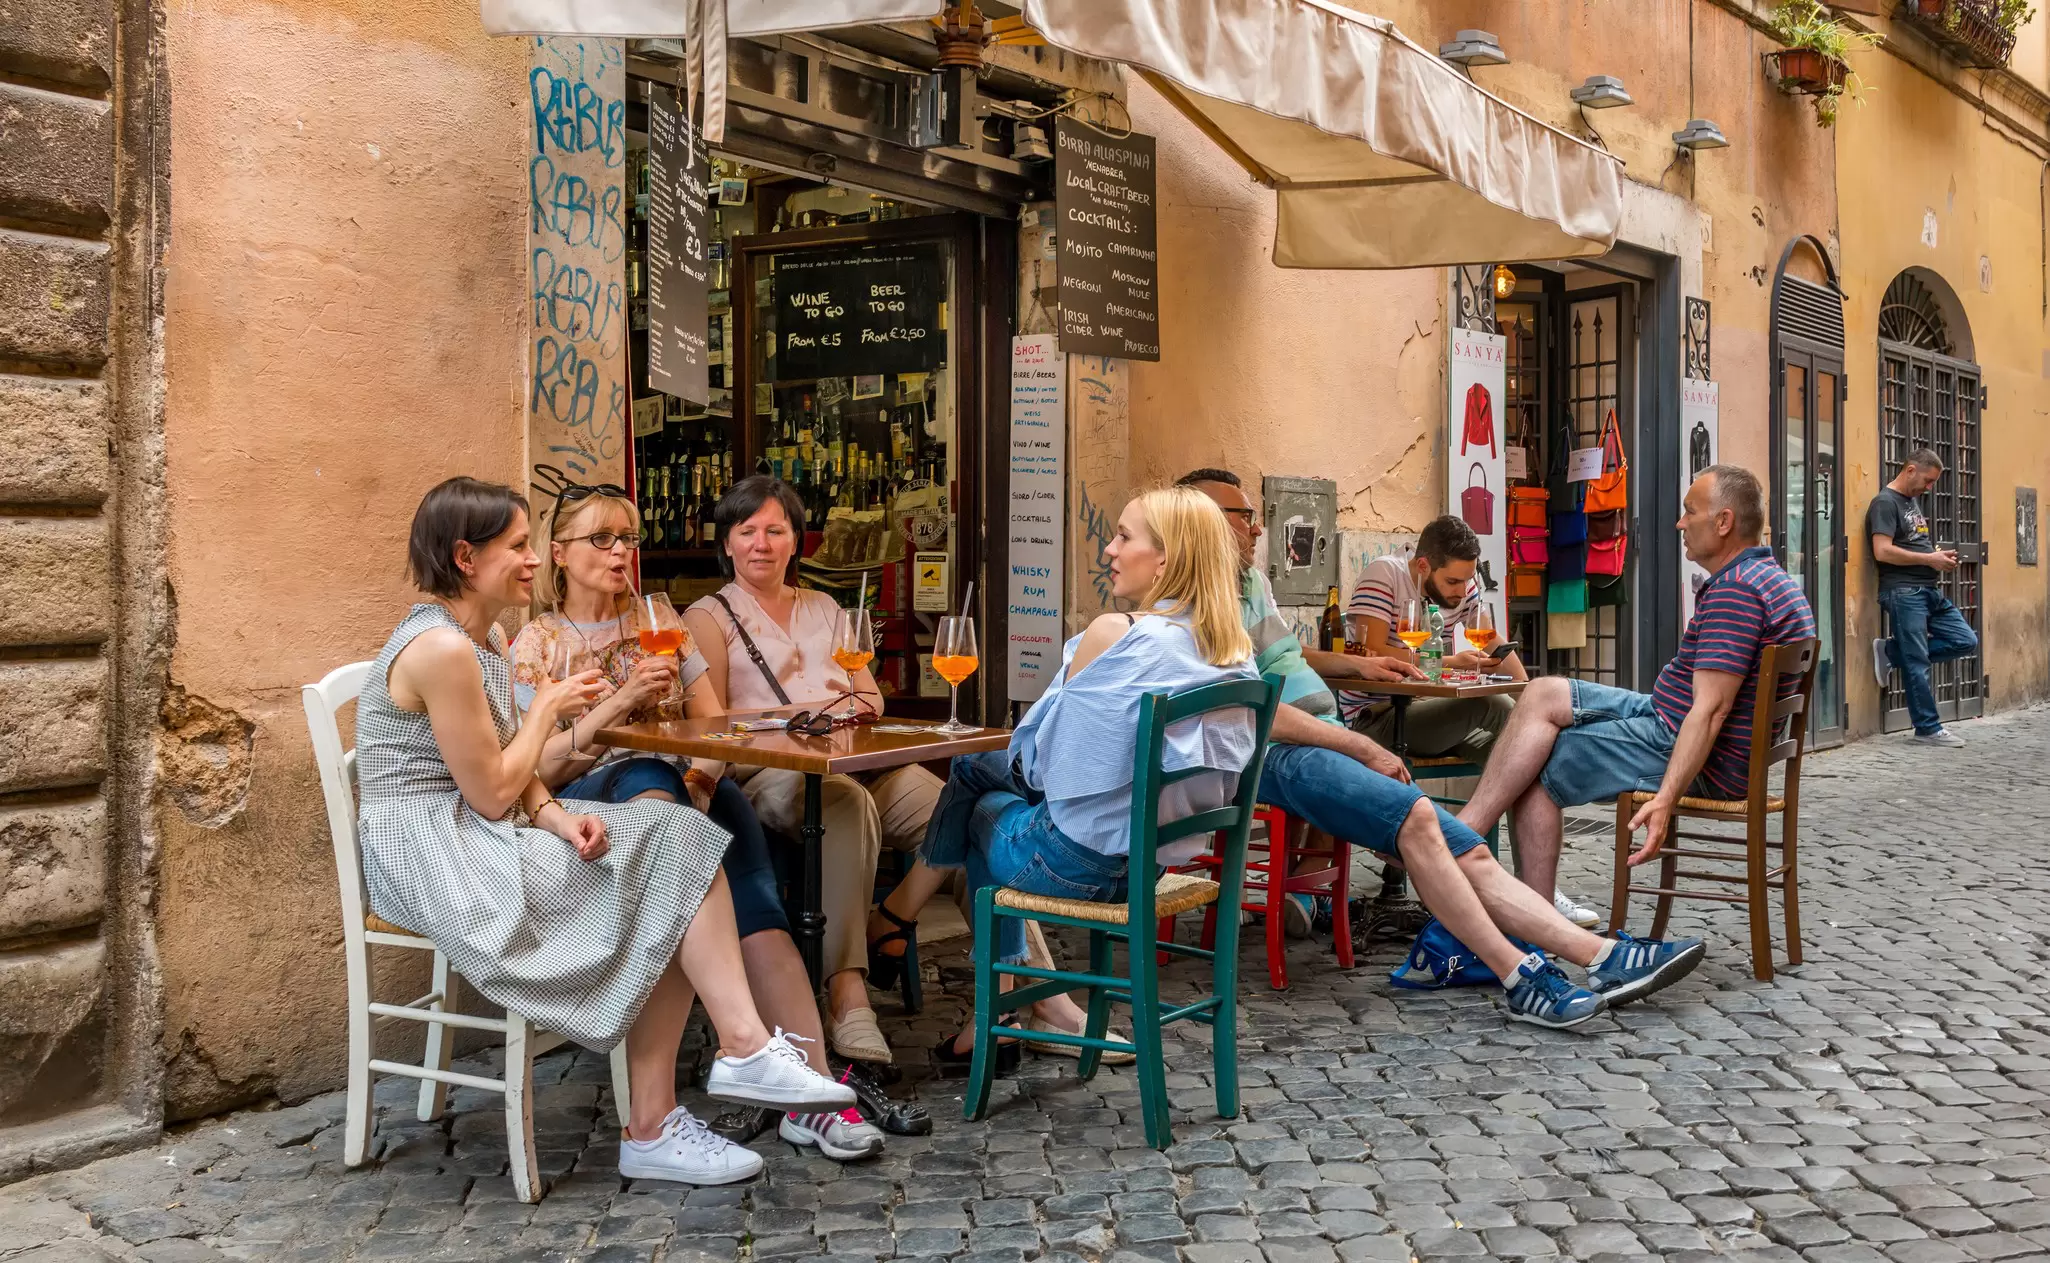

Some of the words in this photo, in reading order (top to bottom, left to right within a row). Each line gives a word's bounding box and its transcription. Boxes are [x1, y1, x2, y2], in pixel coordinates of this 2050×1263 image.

[1058, 130, 1090, 156] BIRRA
[1108, 242, 1156, 262] CAIPIRINHA
[870, 284, 906, 296] BEER
[1062, 276, 1102, 293] NEGRONI
[790, 292, 830, 308] WINE
[1128, 288, 1151, 300] MULE
[804, 308, 820, 318] TO
[825, 306, 844, 318] GO
[869, 302, 885, 313] TO
[888, 301, 905, 312] GO
[1106, 302, 1155, 322] AMERICANO
[1064, 308, 1090, 324] IRISH
[862, 328, 888, 344] FROM
[890, 328, 926, 342] €2,50
[1066, 324, 1094, 336] CIDER
[1100, 324, 1124, 338] WINE
[788, 333, 816, 350] FROM
[820, 333, 842, 346] €5
[1124, 339, 1158, 354] PROSECCO
[1455, 342, 1502, 362] SANYA
[1684, 390, 1716, 405] SANYA
[1011, 515, 1051, 523] COCKTAILS
[1012, 565, 1050, 578] WHISKY
[1023, 585, 1045, 598] RUM
[1010, 605, 1058, 617] CHAMPAGNE
